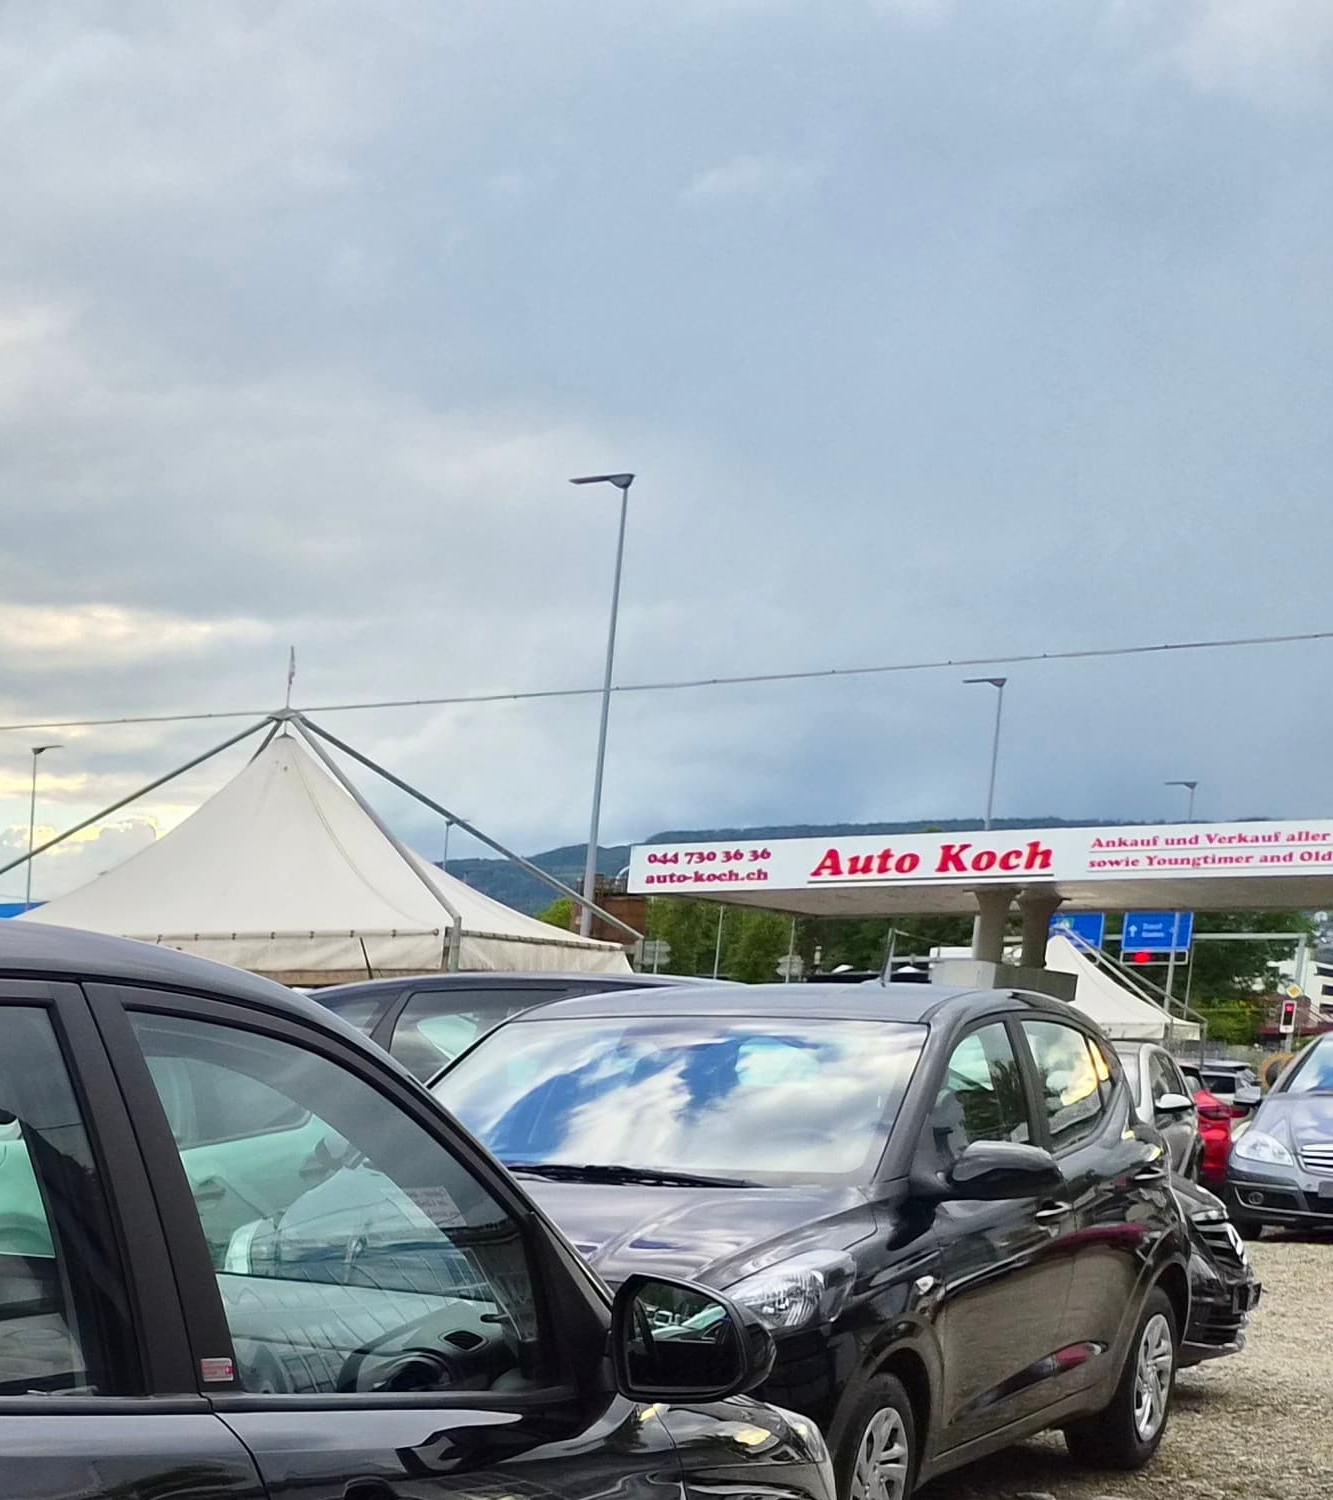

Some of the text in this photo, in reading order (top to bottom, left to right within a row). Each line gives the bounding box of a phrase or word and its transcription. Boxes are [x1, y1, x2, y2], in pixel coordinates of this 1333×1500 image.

[1091, 830, 1332, 849] Ankauf und Verkauf aller
[647, 847, 772, 865] 044 730 36 36
[810, 840, 1053, 877] Auto Koch
[1088, 855, 1140, 868] sowie
[1145, 852, 1255, 869] Youngtimer
[1298, 850, 1333, 863] Old
[645, 868, 769, 885] auto-koch.ch
